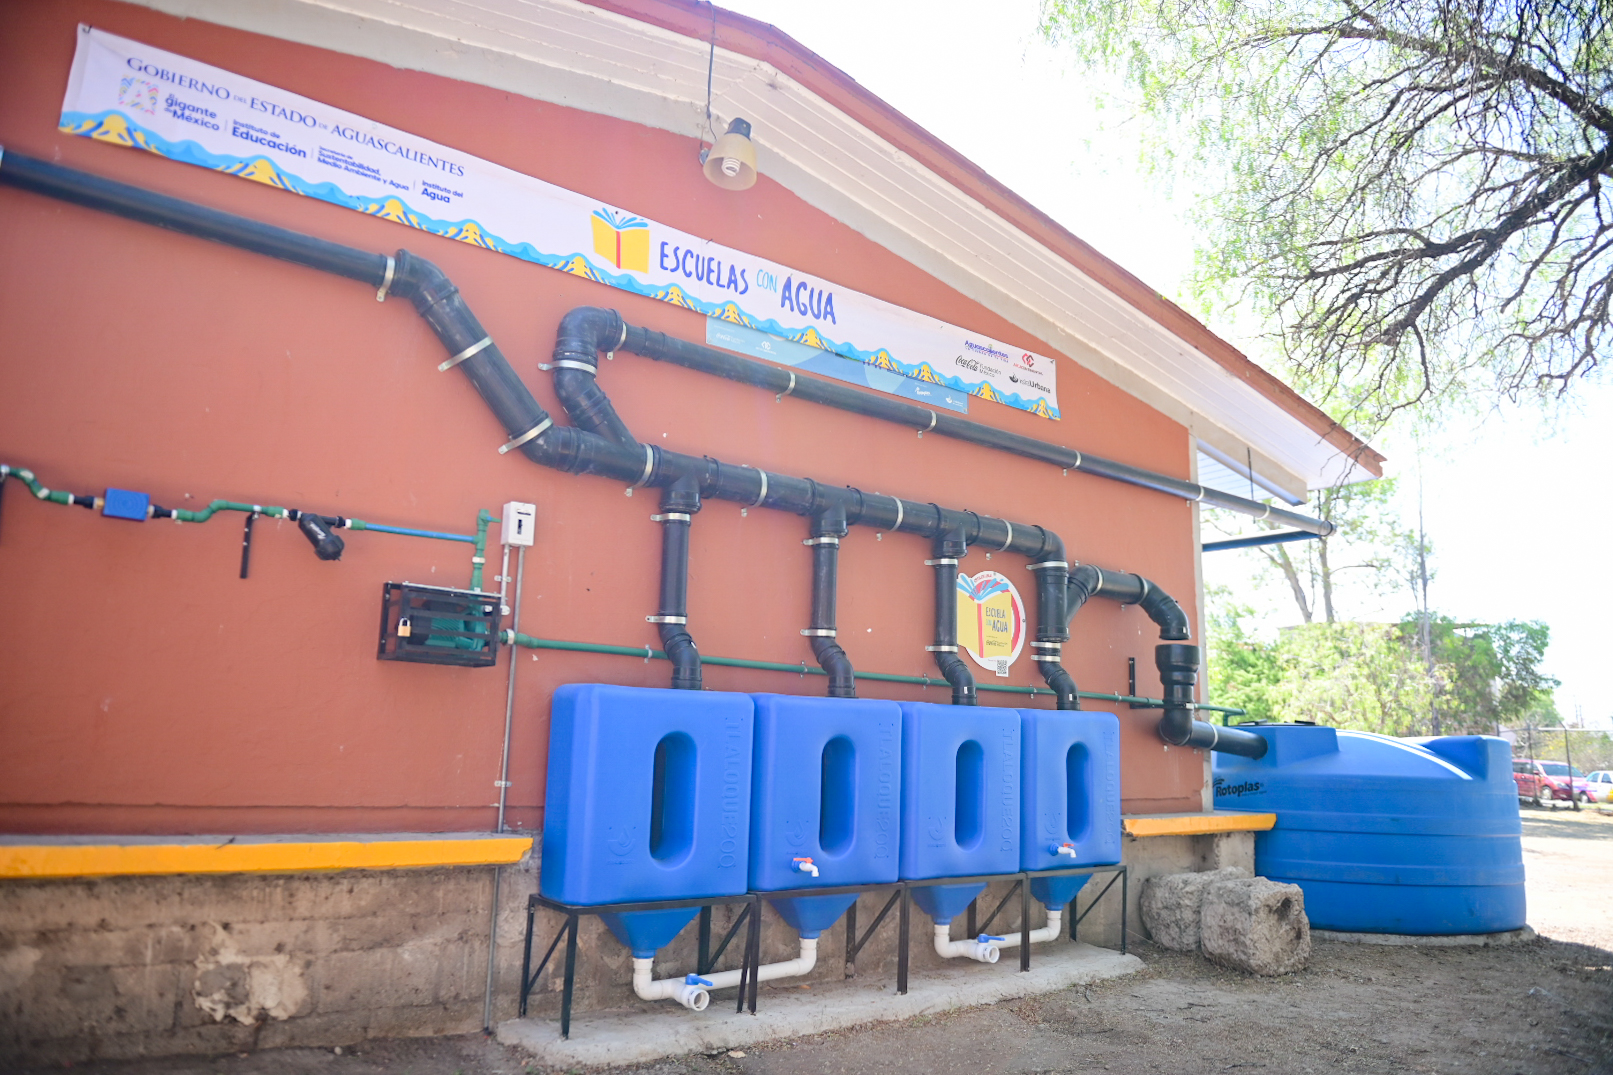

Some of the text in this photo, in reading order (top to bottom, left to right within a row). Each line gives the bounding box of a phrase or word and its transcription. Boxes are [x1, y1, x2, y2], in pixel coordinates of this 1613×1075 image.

[127, 57, 230, 100] GOBIERNO
[250, 96, 317, 128] ESTADO
[331, 124, 465, 177] AGUASCALIENTES
[165, 96, 217, 119] gigante
[172, 109, 220, 131] México
[233, 119, 280, 139] Instituto de
[232, 126, 307, 158] Educación
[317, 157, 410, 192] Medio Ambiente y Agua
[421, 180, 464, 199] Instituto del
[421, 187, 451, 204] Agua
[660, 241, 837, 325] ESCUELAS CON AGUA
[992, 619, 1009, 633] AGUA
